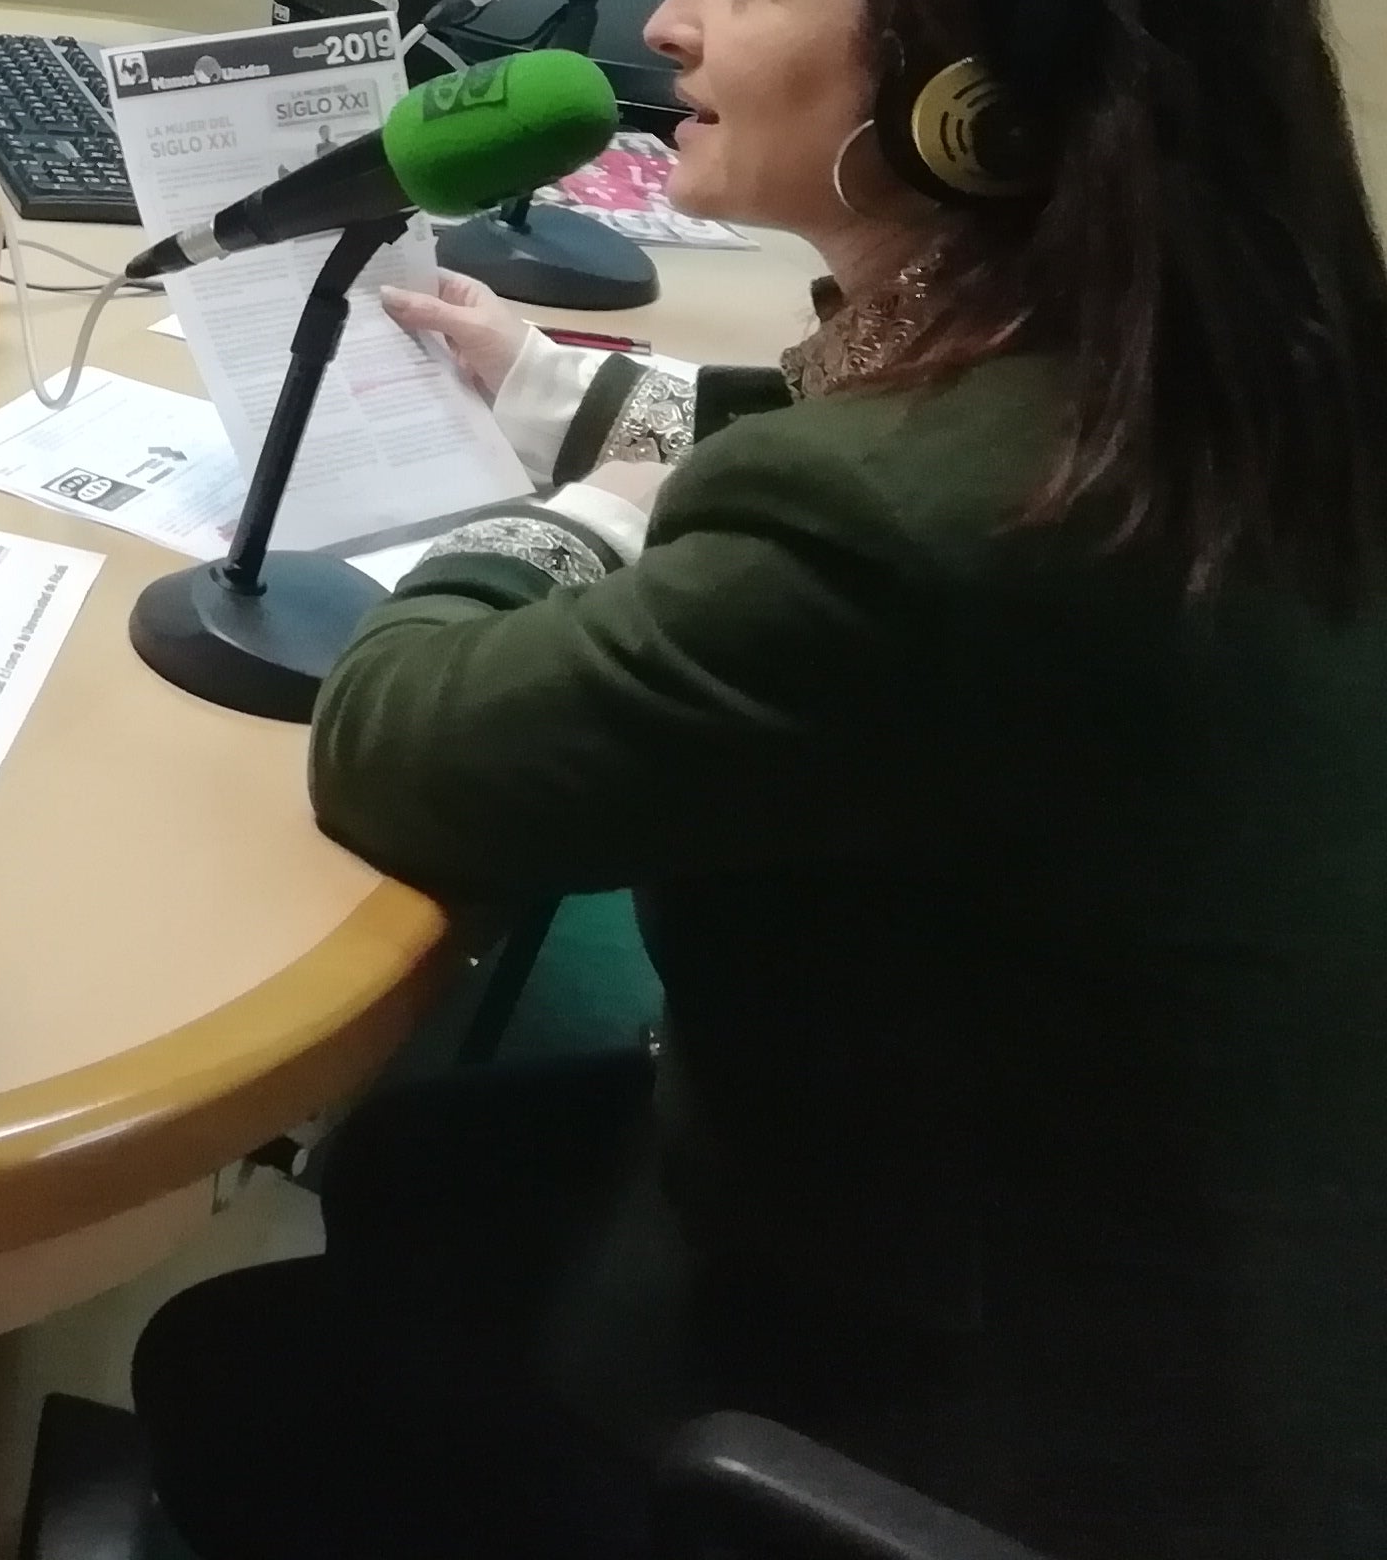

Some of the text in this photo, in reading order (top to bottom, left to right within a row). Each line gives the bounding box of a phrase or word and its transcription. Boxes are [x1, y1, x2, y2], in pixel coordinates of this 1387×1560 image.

[326, 29, 395, 64] 2019
[276, 92, 370, 120] SIGLO XXI
[146, 117, 234, 138] LA MUJER DEL
[150, 132, 238, 159] SIGLO XXI
